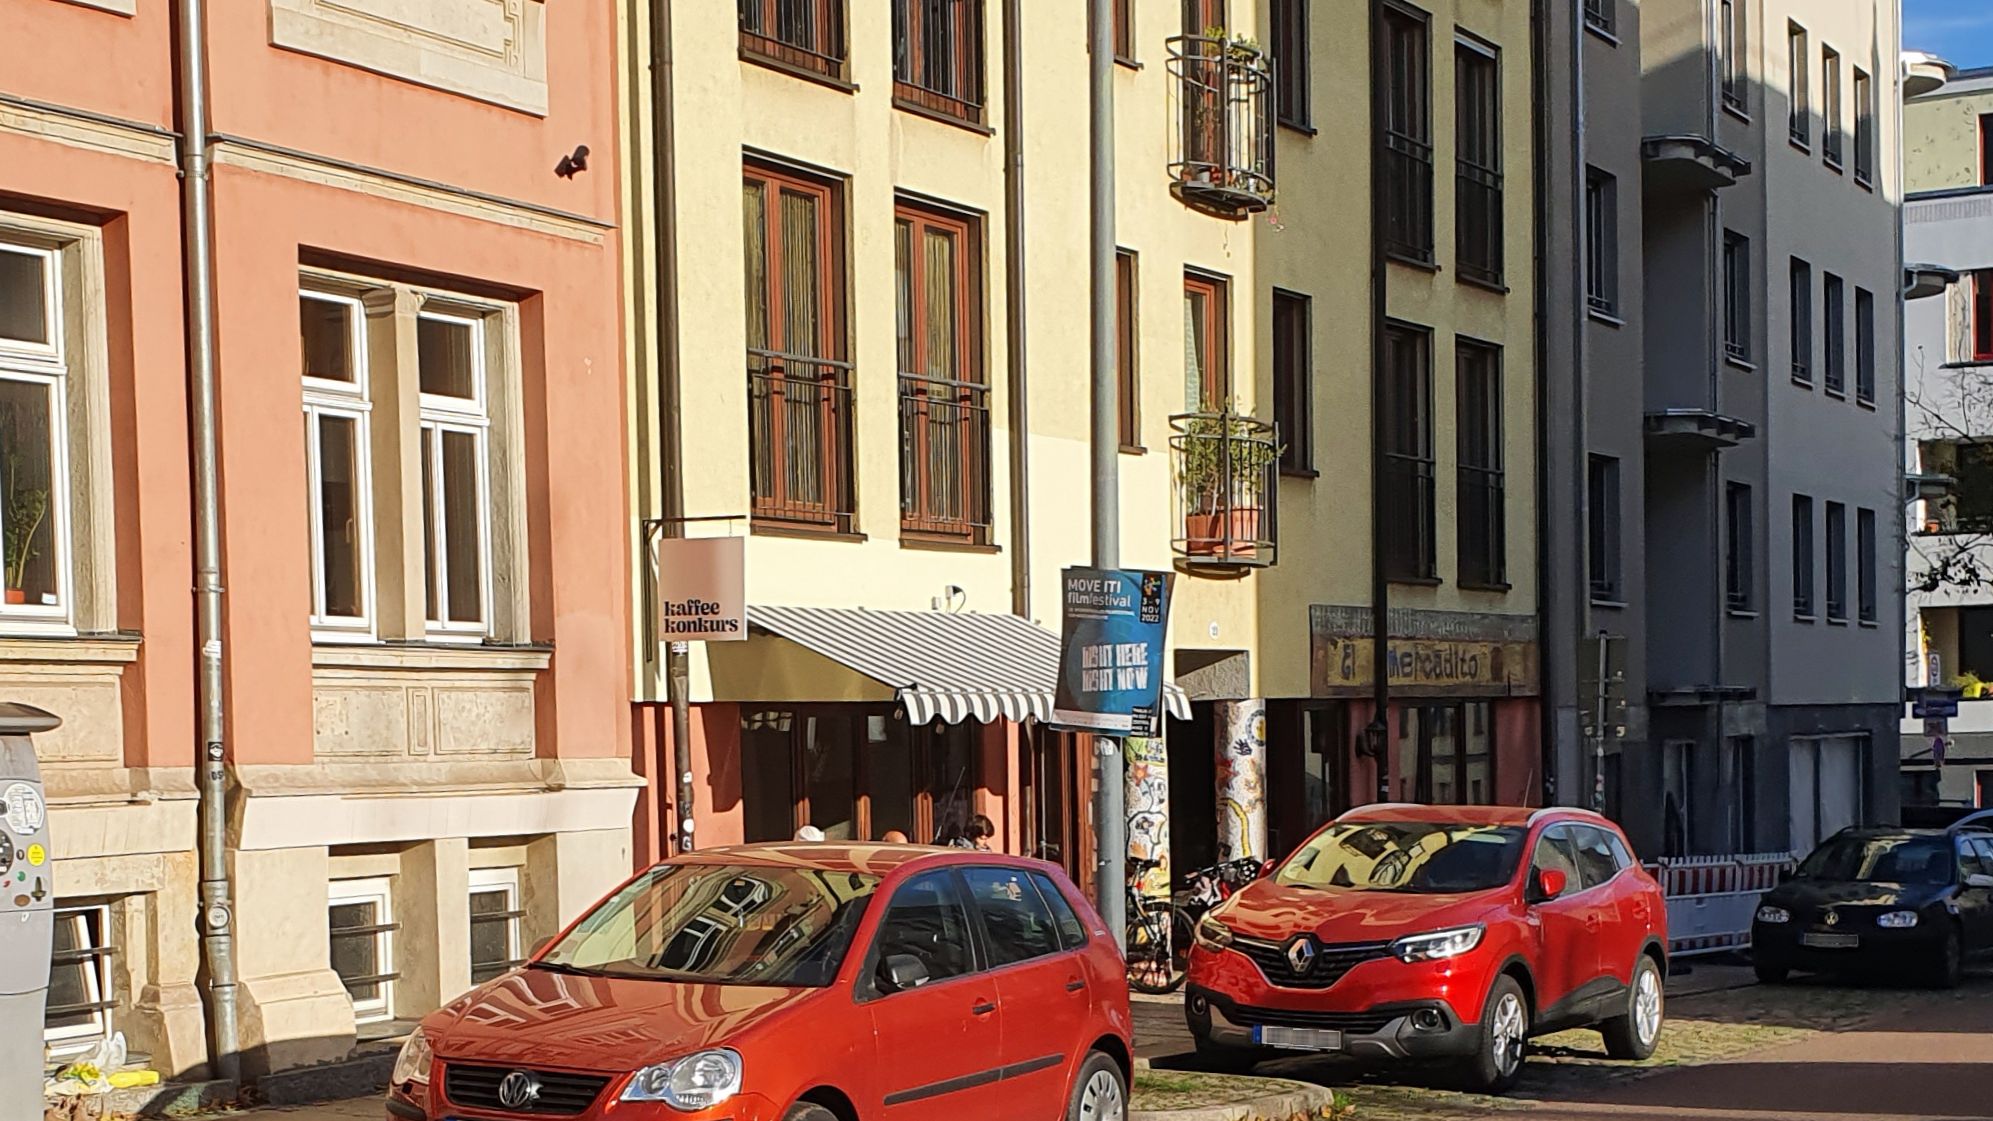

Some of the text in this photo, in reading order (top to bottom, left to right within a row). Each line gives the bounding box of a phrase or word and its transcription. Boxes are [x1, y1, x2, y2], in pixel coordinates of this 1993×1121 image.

[1067, 579, 1101, 593] MOVE
[664, 599, 720, 616] kaffee
[1067, 592, 1132, 608] filmfestival
[1141, 606, 1160, 614] NOV
[1141, 614, 1160, 622] 2022
[664, 617, 739, 633] konkurs
[1115, 642, 1148, 667] HERE
[1116, 666, 1148, 690] NOW
